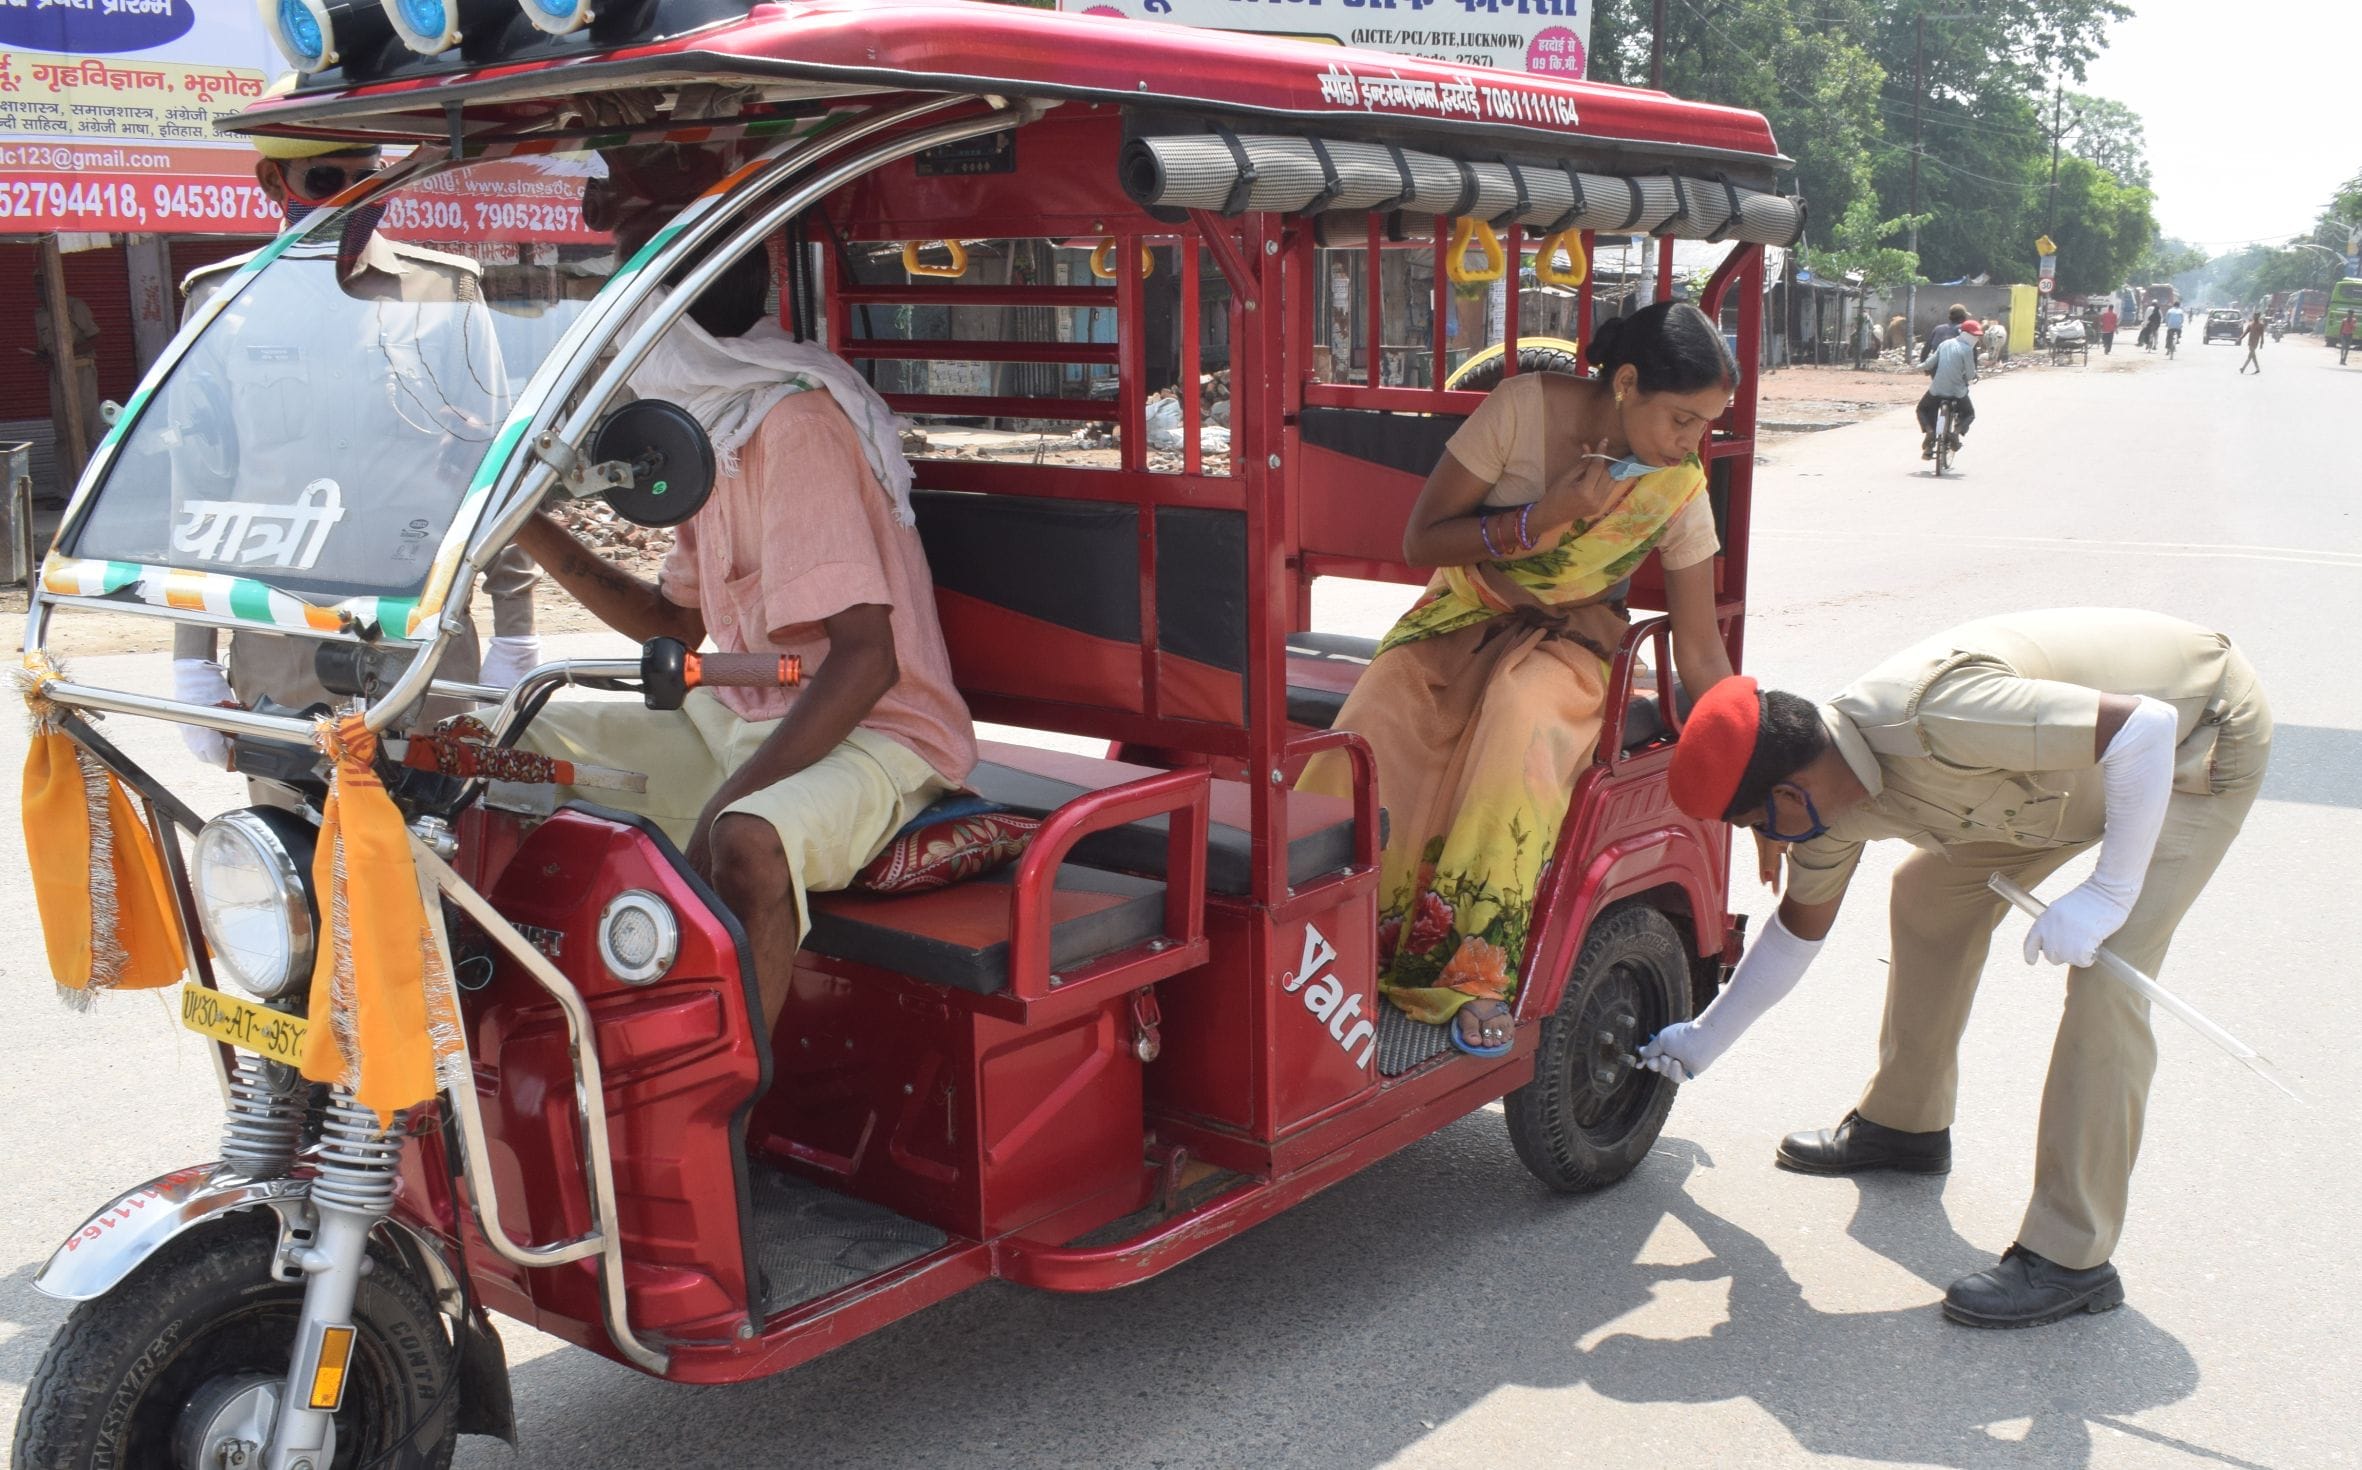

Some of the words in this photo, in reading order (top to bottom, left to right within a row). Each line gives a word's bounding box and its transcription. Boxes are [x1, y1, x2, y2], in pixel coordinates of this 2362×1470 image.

[184, 70, 265, 102] भूगोल
[165, 105, 208, 121] अंग्रेजी
[78, 117, 116, 134] अंग्रेजी
[2040, 280, 2052, 290] 30
[172, 477, 346, 570] यात्री
